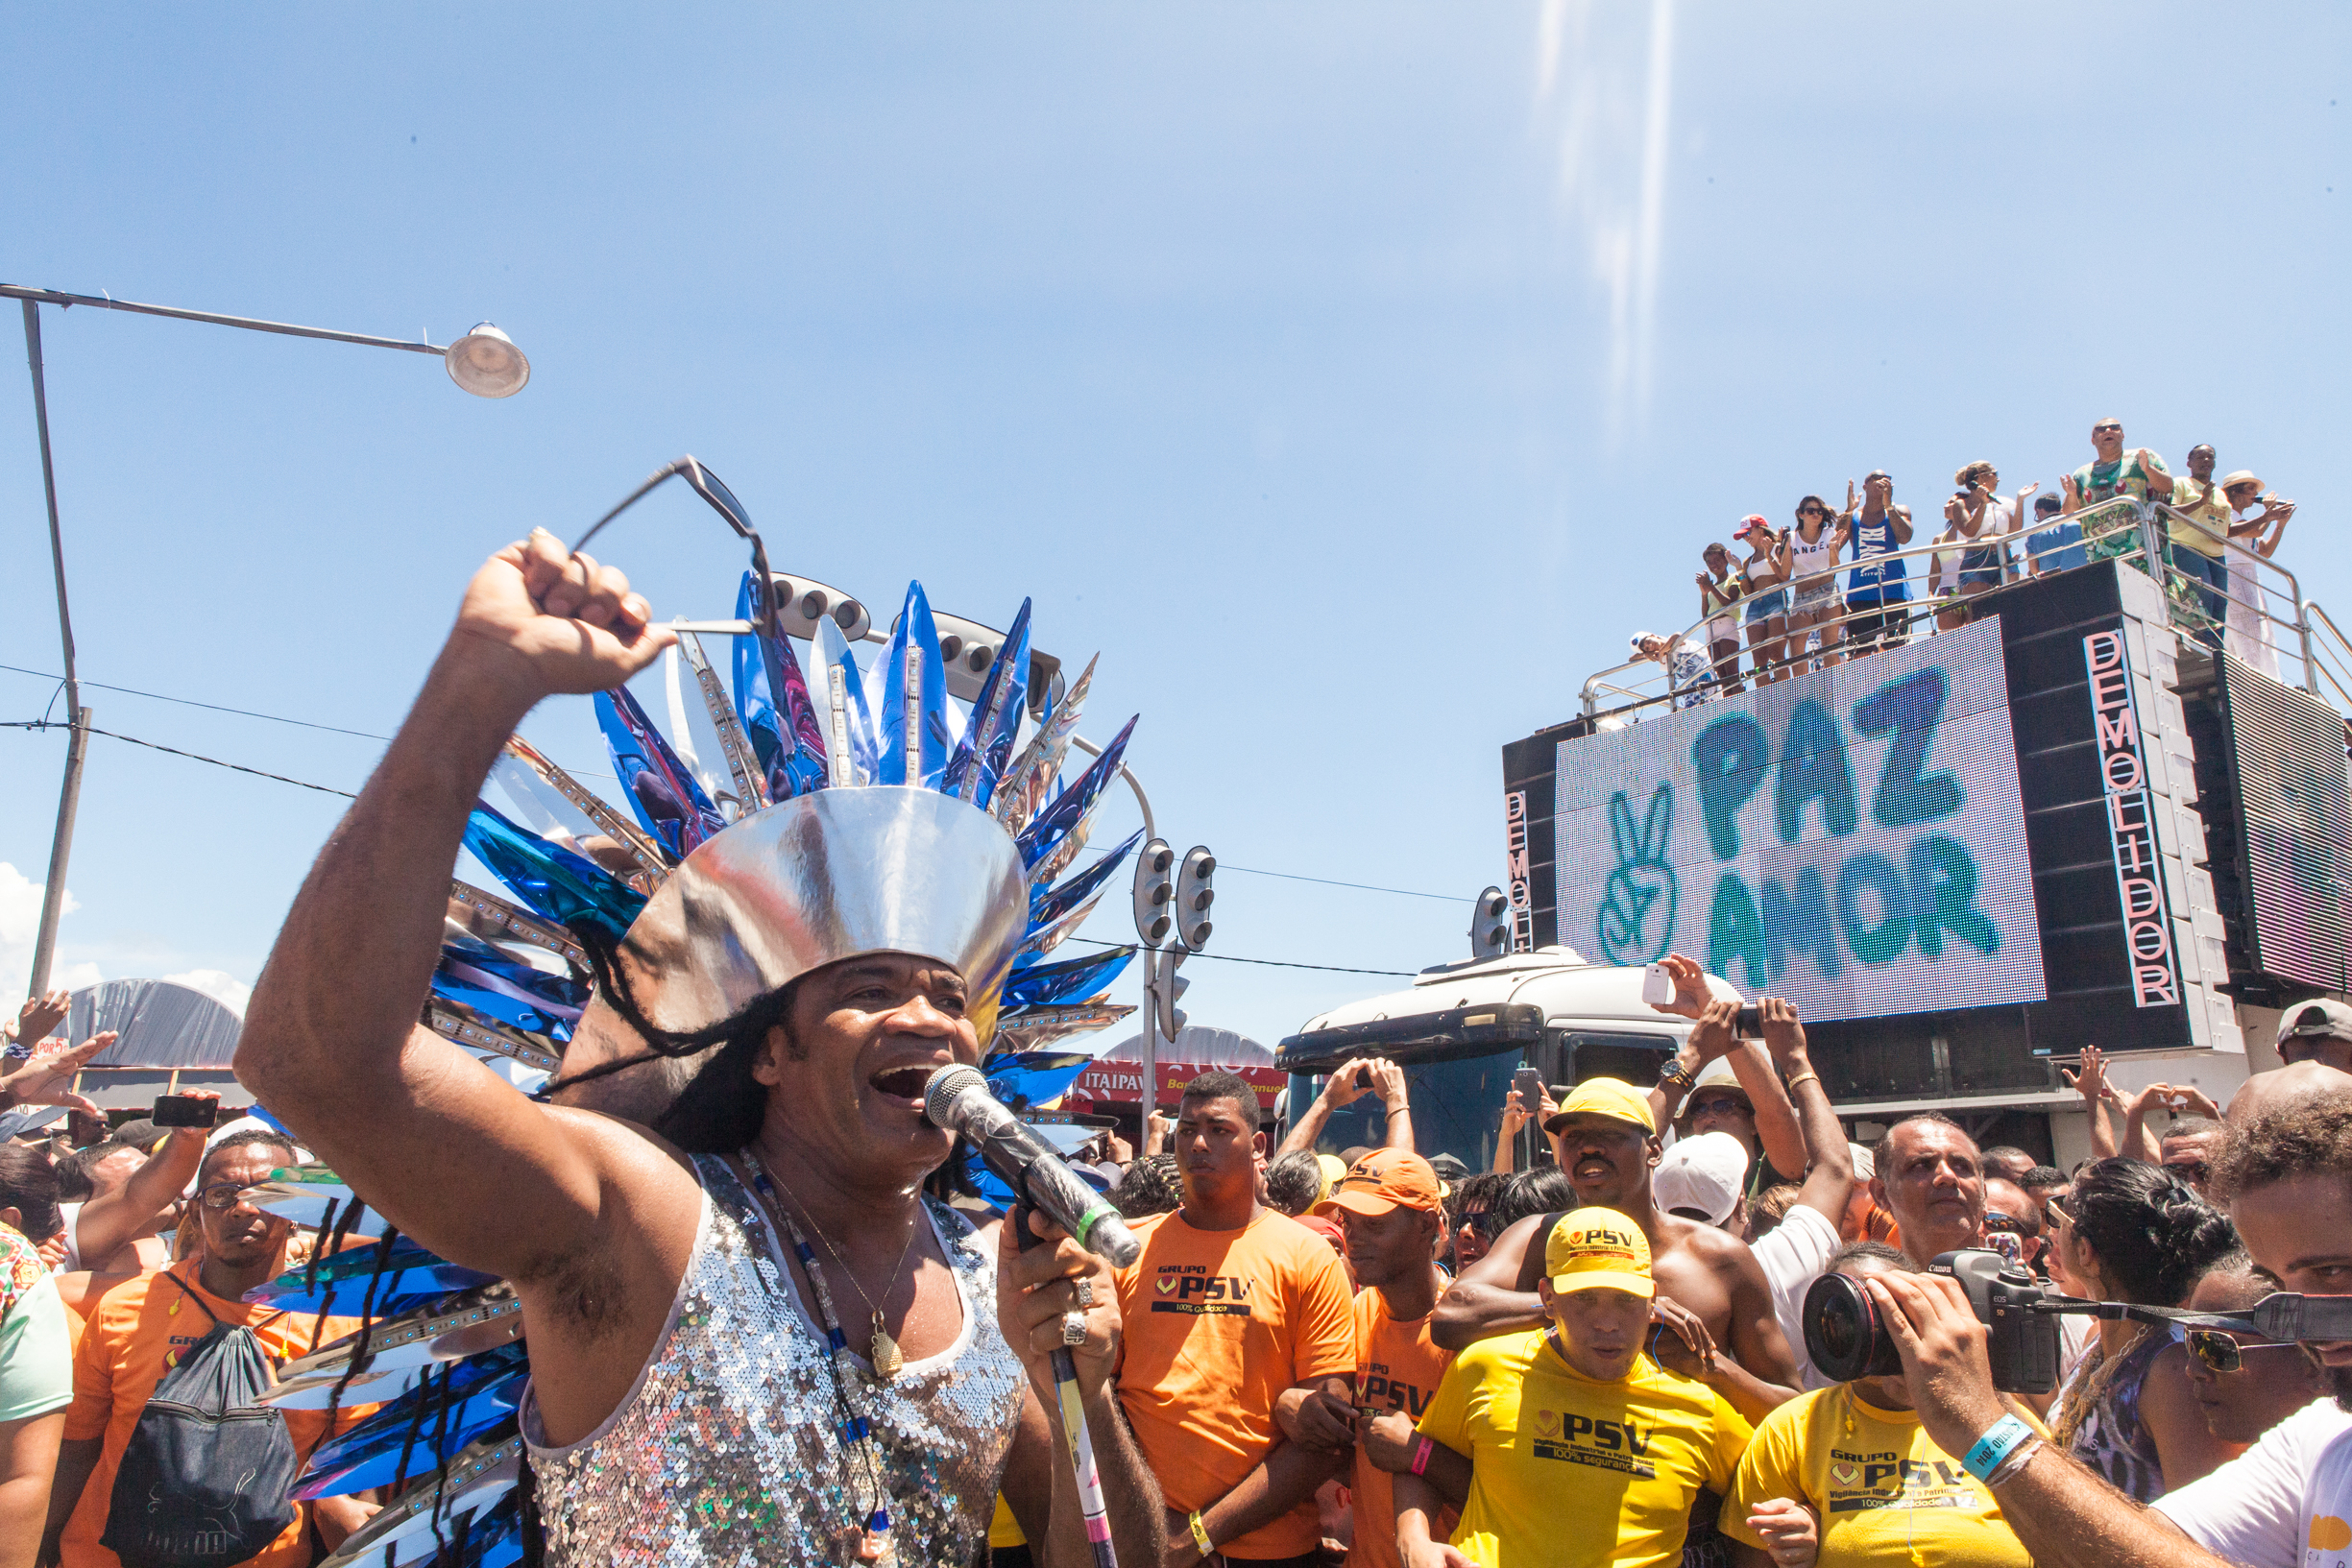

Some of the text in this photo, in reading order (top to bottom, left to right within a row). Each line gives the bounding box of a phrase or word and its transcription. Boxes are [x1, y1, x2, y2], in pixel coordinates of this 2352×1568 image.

[1693, 664, 1967, 860] PAZ
[2085, 631, 2174, 1004] DEMOLIDOR
[1708, 833, 2000, 989] AMOR
[1248, 1082, 1286, 1093] anuel
[1586, 1230, 1632, 1246] PSV
[1157, 1265, 1206, 1274] GRUPO
[1928, 1264, 1952, 1273] Canon
[1178, 1276, 1254, 1300] PSV
[1176, 1303, 1227, 1313] 100% Qualidade
[1365, 1375, 1434, 1417] PSV
[1563, 1412, 1653, 1456] PSV
[1570, 1440, 1606, 1456] Industrial
[1831, 1449, 1897, 1462] GRUPO
[1976, 1445, 1996, 1467] 2014
[1553, 1447, 1637, 1473] 100% segurança
[1864, 1459, 1965, 1488] PSV
[1830, 1489, 1870, 1499] Vigilância
[1861, 1498, 1942, 1508] 100% Qualidade
